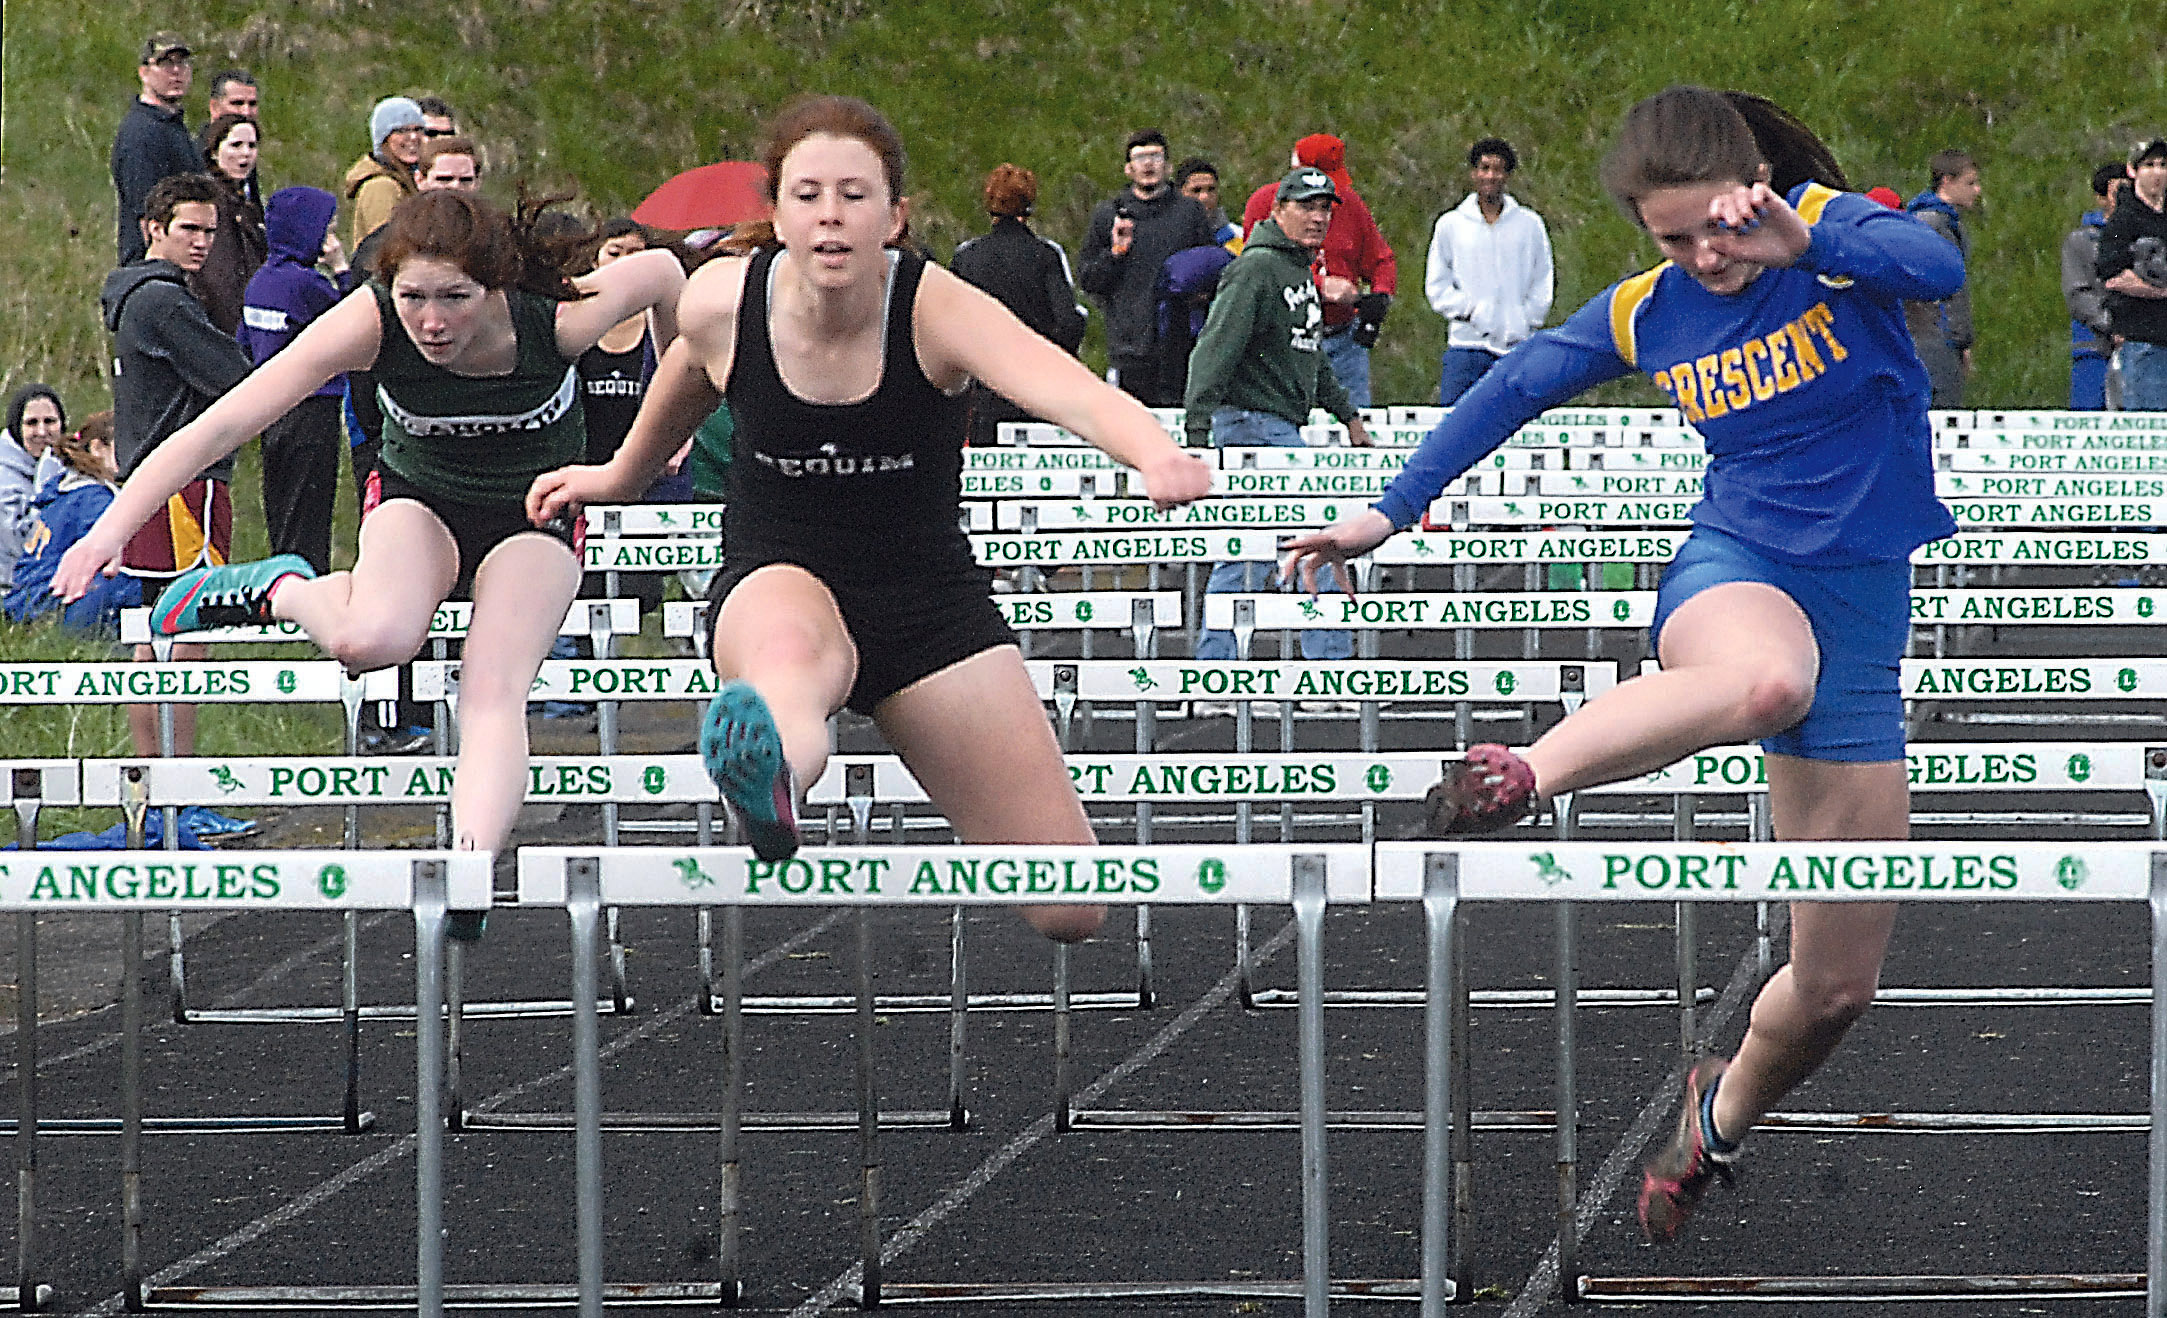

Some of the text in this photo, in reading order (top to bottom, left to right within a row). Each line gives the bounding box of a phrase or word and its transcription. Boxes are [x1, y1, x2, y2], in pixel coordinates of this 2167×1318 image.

[2110, 417, 2167, 430] ANGEL
[2023, 435, 2076, 448] PORT
[970, 453, 1113, 470] PORT ANGEL
[1313, 453, 1371, 469] PORT
[2008, 454, 2067, 470] PORT
[964, 476, 1023, 492] ELES
[1226, 475, 1393, 493] PORT ANGELE
[1603, 476, 1666, 493] PORT
[1982, 478, 2164, 497] PORT ANGELES
[1185, 504, 1306, 523] ANGELES
[1539, 502, 1687, 520] PORT ANGE
[1952, 504, 2152, 522] PORT ANGELES
[984, 536, 1208, 561] PORT ANGELES
[1449, 537, 1672, 560] PORT ANGELES
[1924, 538, 2150, 560] PORT ANGELES
[1340, 600, 1592, 623] PORT ANGELES
[1911, 596, 2112, 619] RT ANGELES
[0, 670, 251, 696] RT ANGELES
[569, 667, 672, 694] PORT
[1181, 669, 1469, 696] PORT ANGELES
[1915, 667, 2091, 694] ANGELES
[1070, 763, 1336, 795] RT ANGELES
[1907, 753, 2036, 784] GELES
[270, 765, 612, 797] PORT ANLES
[30, 862, 281, 901] ANGELES
[744, 856, 1160, 896] PORT ANGELES
[1600, 854, 1747, 890] PORT
[1766, 854, 2018, 891] ANGELES
